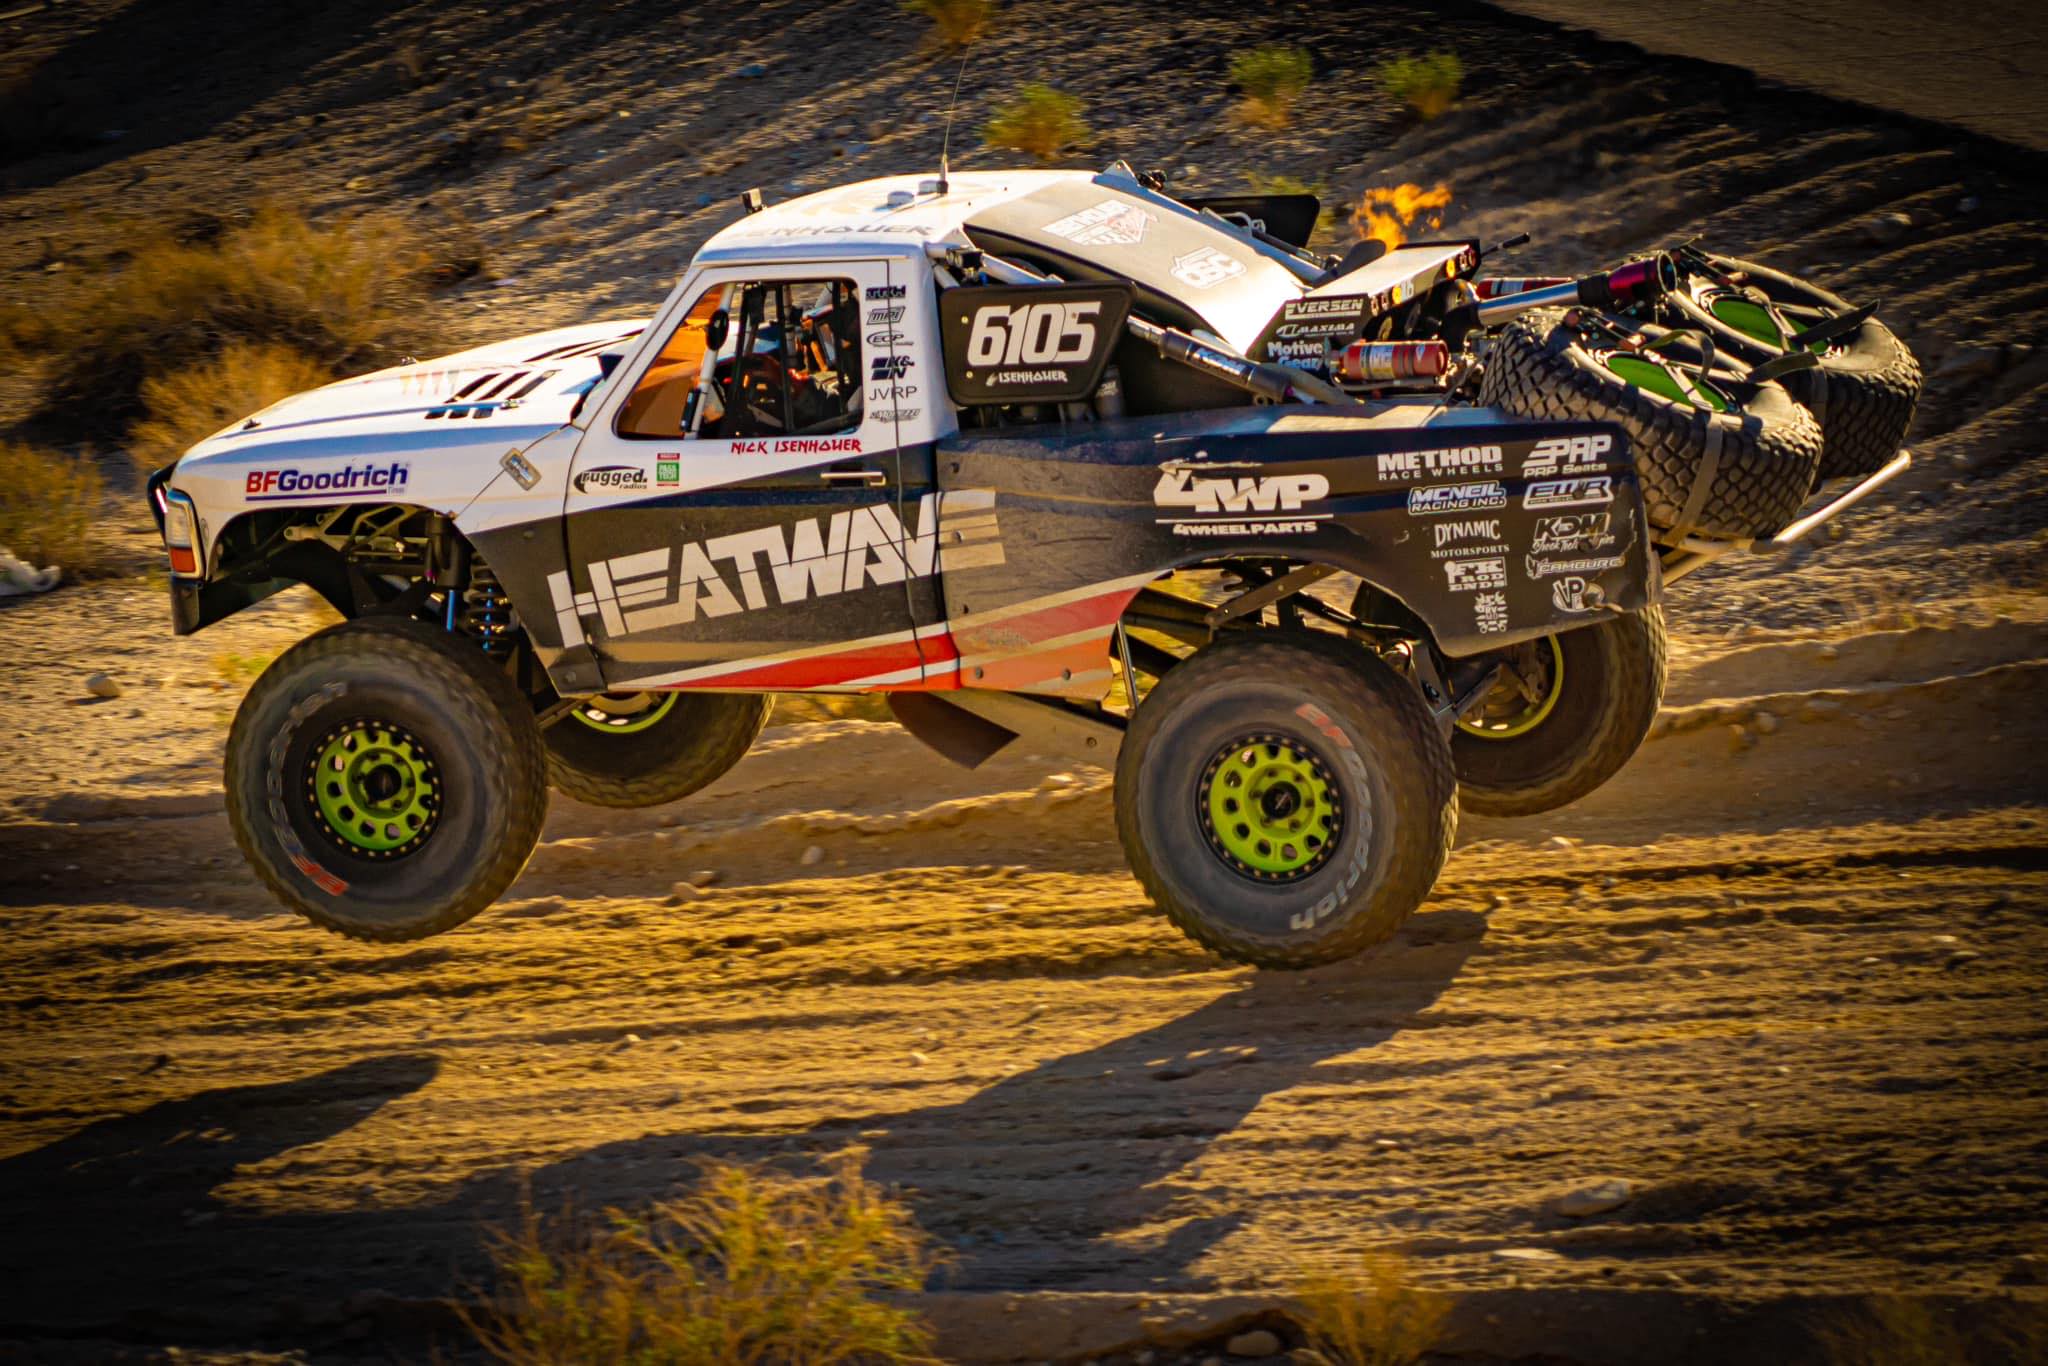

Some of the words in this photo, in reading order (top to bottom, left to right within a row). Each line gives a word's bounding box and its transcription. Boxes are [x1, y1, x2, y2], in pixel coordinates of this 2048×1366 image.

[1285, 299, 1364, 320] EVERSEN
[967, 301, 1101, 367] 6105
[1267, 340, 1323, 356] Motive
[869, 386, 917, 401] JVRP
[731, 441, 768, 455] NICK
[1521, 434, 1612, 469] PRP
[1377, 446, 1503, 472] METHOD
[246, 462, 409, 493] BFGoodrich
[1379, 470, 1422, 481] RACE
[1432, 463, 1504, 476] WHEELS
[1523, 465, 1559, 479] PRP
[1154, 465, 1330, 513] 4WP
[1411, 482, 1503, 503] MCNEIL
[1411, 498, 1469, 513] RACING
[1434, 519, 1501, 548] DYNAMIC
[1534, 512, 1611, 540] KDM
[1430, 543, 1510, 558] MOTORSPORTS
[547, 486, 1006, 650] HEATWAVE
[1461, 574, 1504, 583] ROD
[1448, 580, 1505, 591] ENDS
